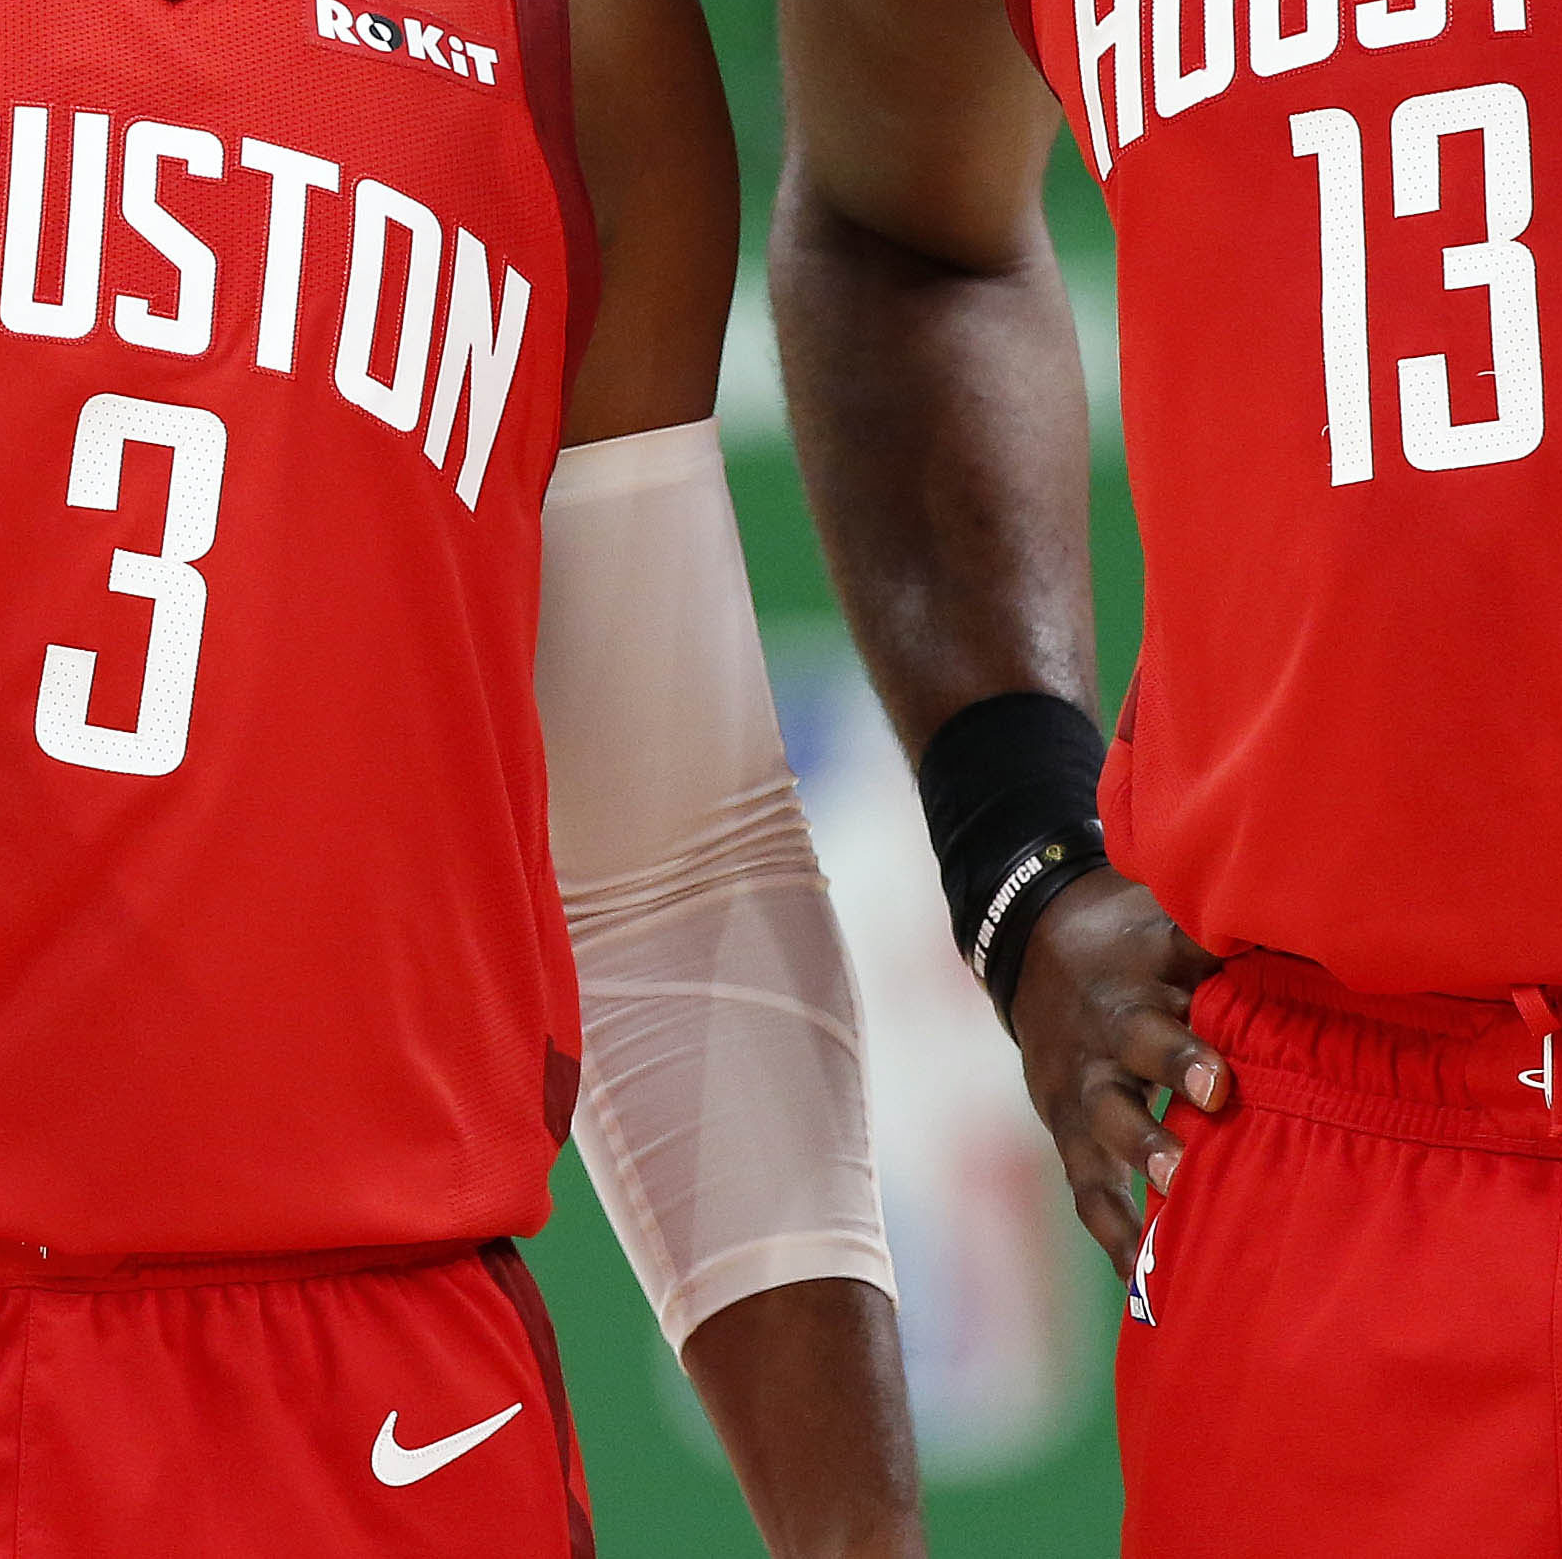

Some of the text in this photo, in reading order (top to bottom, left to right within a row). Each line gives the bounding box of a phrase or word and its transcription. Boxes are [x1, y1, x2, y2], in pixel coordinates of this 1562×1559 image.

[1289, 82, 1544, 487] 13
[35, 393, 228, 776] 3
[987, 855, 1043, 924] SWITCH
